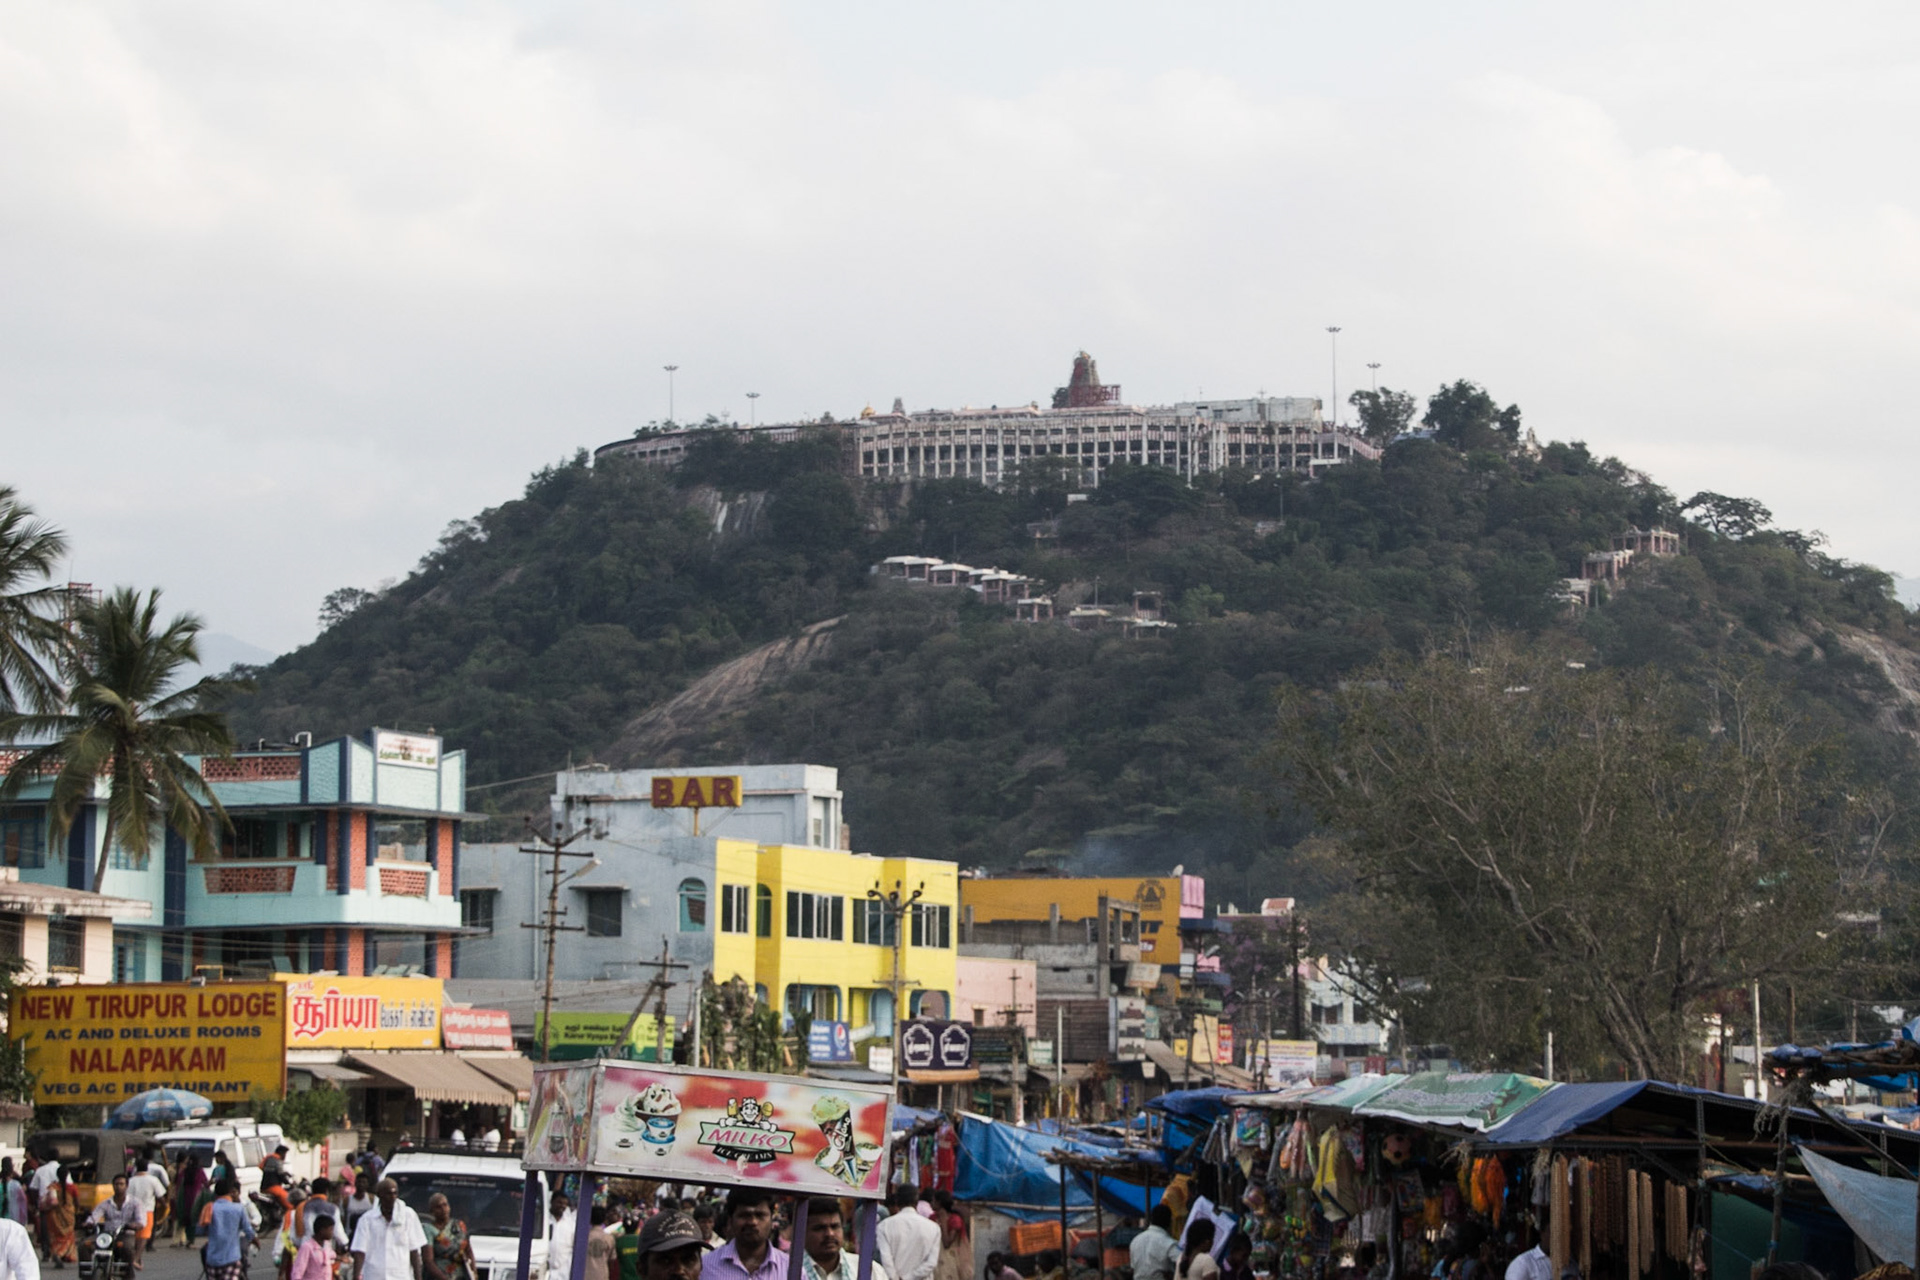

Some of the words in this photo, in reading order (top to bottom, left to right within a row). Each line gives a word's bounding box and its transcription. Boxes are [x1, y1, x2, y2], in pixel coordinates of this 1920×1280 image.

[652, 778, 736, 807] BAR
[20, 996, 74, 1020] NEW
[85, 993, 187, 1019] TIRUPUR
[198, 992, 277, 1018] LODGE
[45, 1028, 72, 1041] A/C
[78, 1028, 114, 1040] AND
[120, 1027, 190, 1039] DELUXE
[197, 1026, 262, 1038] ROOMS
[70, 1046, 226, 1073] NALAPAKAM
[595, 1046, 629, 1059] ATM
[43, 1083, 81, 1095] VEG
[87, 1082, 116, 1094] A/C
[124, 1081, 251, 1094] RESTAURANT
[707, 1128, 788, 1149] MILKO
[716, 1147, 731, 1157] ICE
